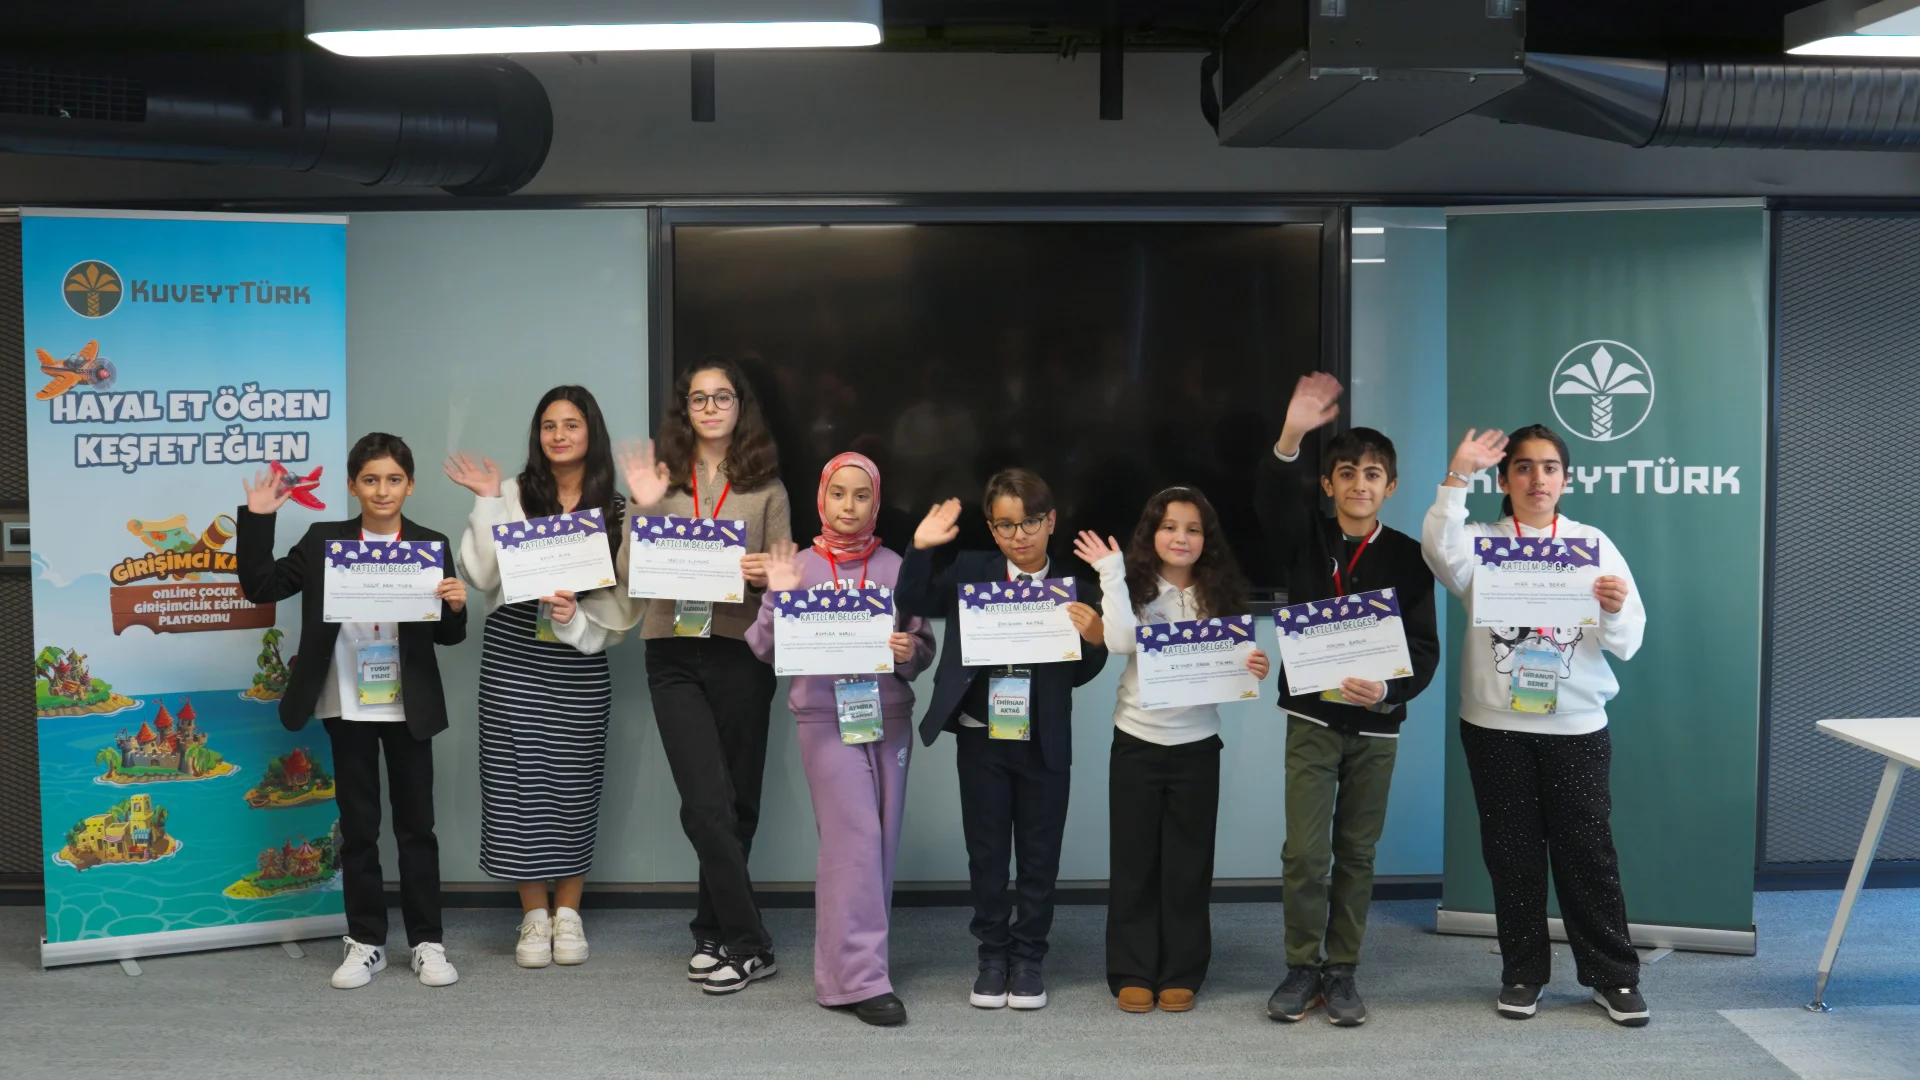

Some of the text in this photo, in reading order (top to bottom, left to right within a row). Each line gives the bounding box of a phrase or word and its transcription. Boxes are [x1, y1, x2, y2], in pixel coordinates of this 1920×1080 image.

[51, 383, 329, 422] HAYAL ET ÖĞREN
[76, 425, 308, 472] KEŞFET EĞLEN
[520, 538, 554, 550] KATILIM
[655, 538, 690, 550] KATILIM
[112, 550, 210, 582] GİRİŞİMCİ
[351, 564, 386, 573] KATILIM
[985, 602, 1020, 613] KATILIM
[800, 612, 836, 622] KATILIM
[1304, 624, 1342, 637] KATILIM
[1162, 644, 1198, 655] KATILIM
